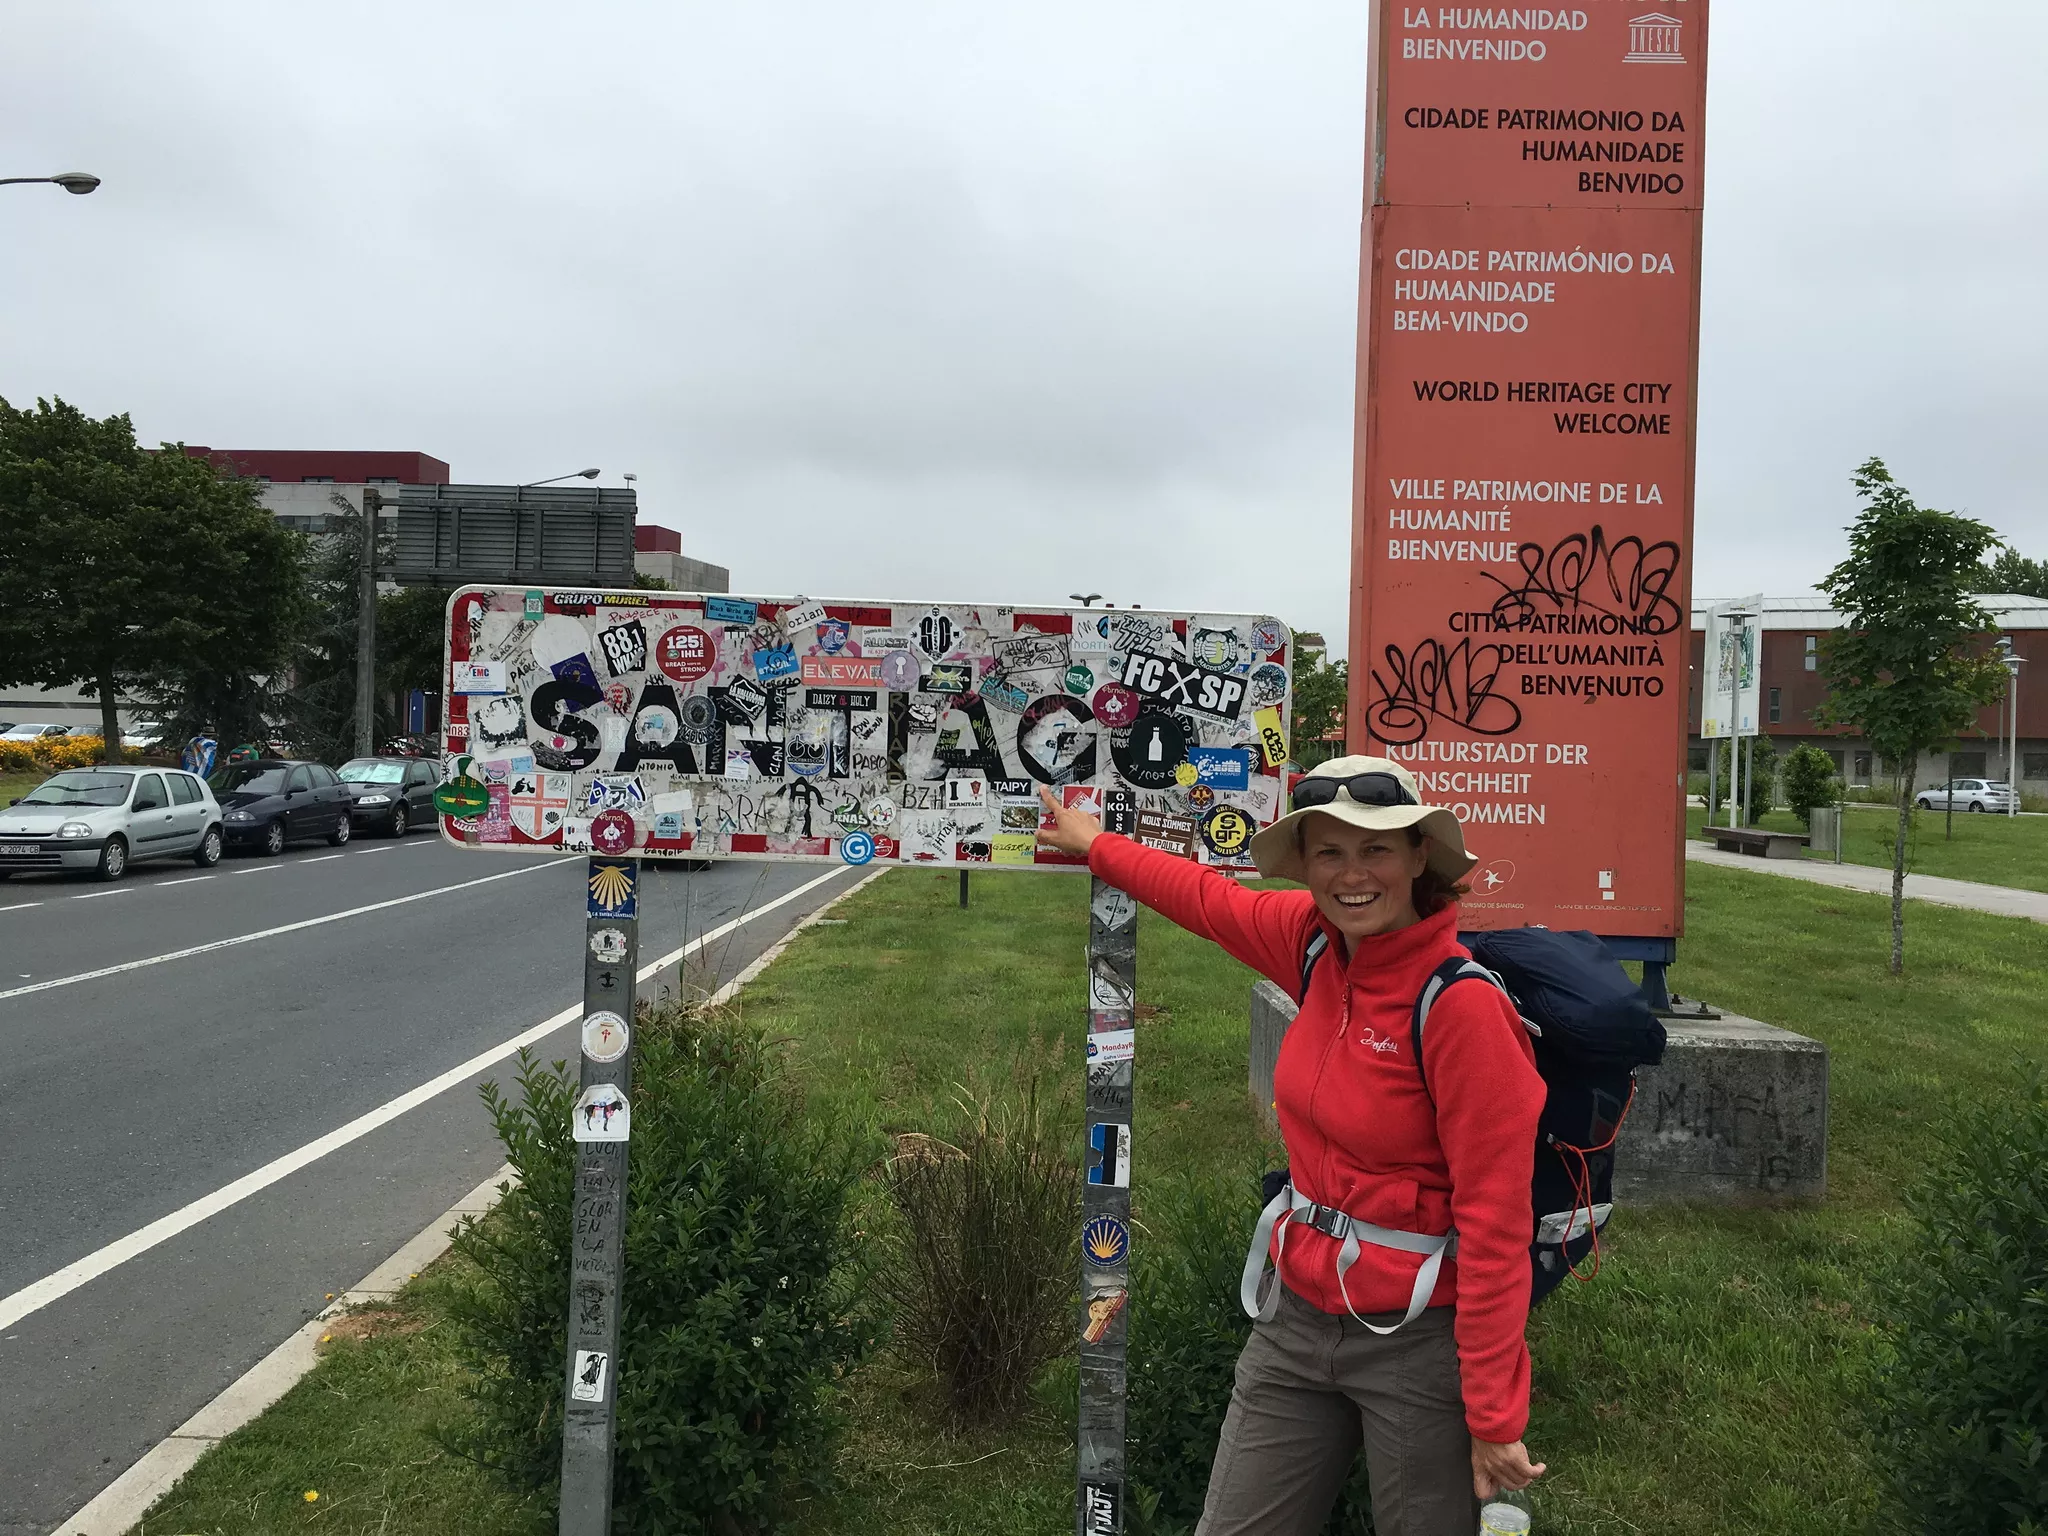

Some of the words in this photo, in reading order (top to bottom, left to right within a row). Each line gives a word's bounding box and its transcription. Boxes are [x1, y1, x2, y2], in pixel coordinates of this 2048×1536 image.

[1403, 8, 1431, 29] LA
[1439, 8, 1588, 31] HUMANIDAD
[1402, 39, 1547, 61] BIENVENIDO
[1630, 27, 1680, 52] UNESCO
[1404, 108, 1488, 129] CIDADE
[1497, 109, 1643, 131] PATRIMONIO
[1652, 112, 1685, 132] DA
[1522, 141, 1684, 163] HUMANIDADE
[1578, 172, 1683, 194] BENVIDO
[1395, 249, 1479, 271] CIDADE
[1487, 246, 1633, 274] PATRIMÓNIO
[1641, 253, 1675, 274] DA
[1394, 280, 1556, 302] HUMANIDADE
[1393, 311, 1528, 332] BEM-VINDO
[1413, 381, 1499, 402] WORLD
[1507, 382, 1615, 403] HERITAGE
[1623, 383, 1672, 403] CITY
[1554, 413, 1670, 435] WELCOME
[1390, 478, 1444, 500] VILLE
[1453, 480, 1591, 503] PATRIMOINE
[1600, 483, 1627, 504] DE
[1636, 483, 1663, 505] LA
[1389, 505, 1511, 532] HUMANITÉ
[1388, 539, 1517, 562] BIENVENUE
[554, 593, 602, 605] GRUPO
[604, 595, 649, 606] MURIEL
[1448, 607, 1511, 633] CITTÀ
[1518, 613, 1665, 635] PATRIMONIO
[667, 635, 699, 649] 125
[1150, 627, 1163, 641] de
[681, 650, 704, 658] IHLE
[1499, 640, 1664, 666] DELL'UMANITÀ
[472, 668, 489, 677] EMC
[1124, 653, 1165, 693] FC
[1198, 675, 1242, 713] SP
[1521, 675, 1664, 697] BENVENUTO
[1385, 741, 1539, 764] KULTURSTADT
[1545, 744, 1588, 765] DER
[1208, 764, 1241, 772] AEGEE
[994, 782, 1028, 792] TAIPY
[1141, 815, 1162, 826] NOUS
[1162, 818, 1192, 832] SOMMES
[7, 846, 26, 854] 2074
[28, 845, 39, 854] CB
[1156, 840, 1180, 852] PAULI
